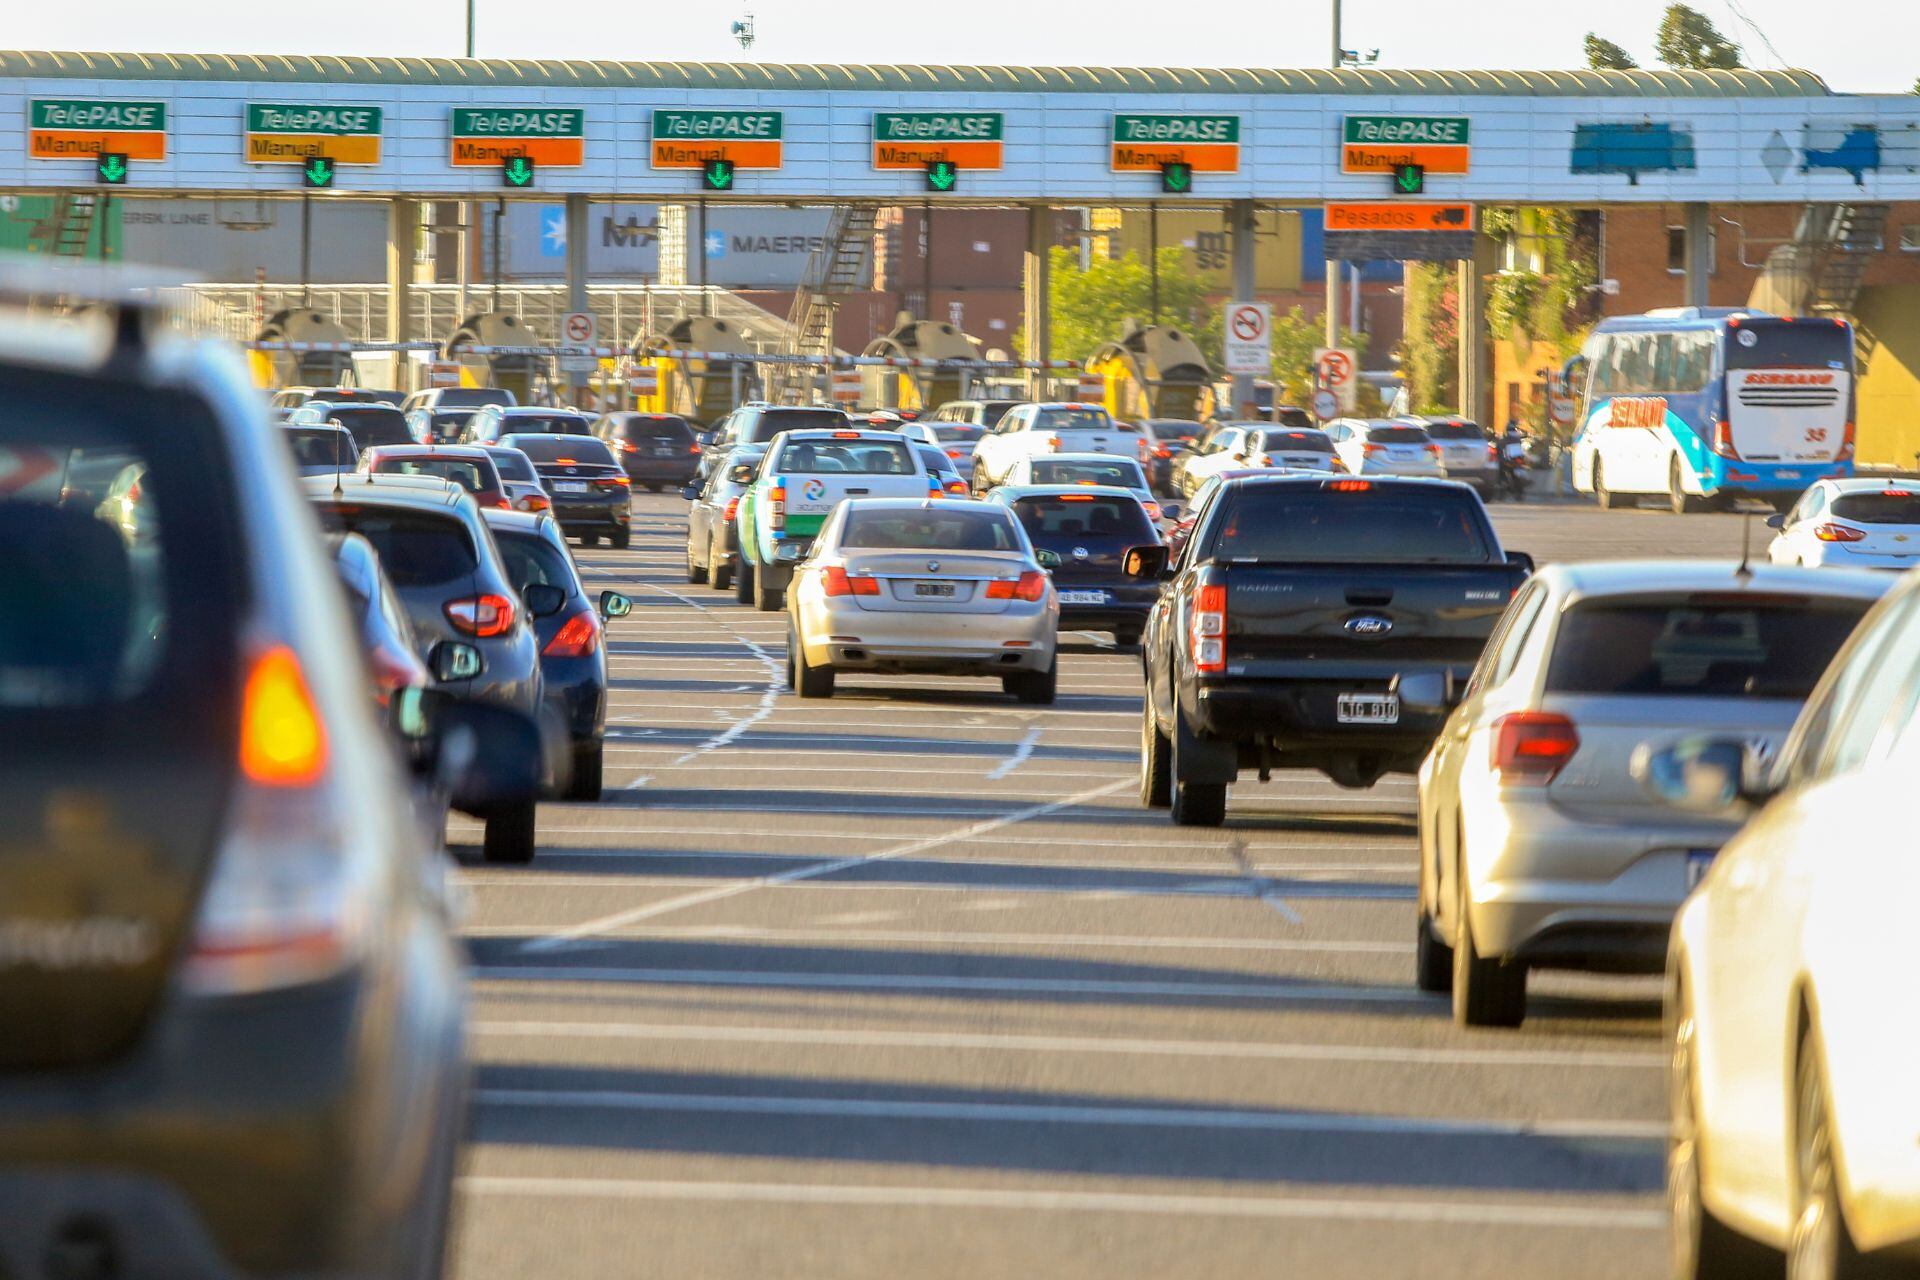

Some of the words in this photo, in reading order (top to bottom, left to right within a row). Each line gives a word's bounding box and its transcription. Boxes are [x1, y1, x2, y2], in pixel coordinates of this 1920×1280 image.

[43, 104, 155, 126] TelePASE
[259, 109, 371, 131] TelePASE
[466, 113, 574, 132] TelePASE
[666, 115, 774, 135] TelePASE
[887, 117, 994, 138] TelePASE
[1124, 119, 1229, 139] TelePASE
[1356, 120, 1459, 142] TelePASE
[35, 135, 108, 152] Manual
[251, 139, 324, 157] Manual
[458, 143, 527, 159] Manual
[657, 146, 726, 162] Manual
[878, 147, 948, 163] Manual
[1117, 149, 1185, 165] Manual
[1347, 150, 1415, 166] Manual
[1334, 208, 1415, 225] Pesados
